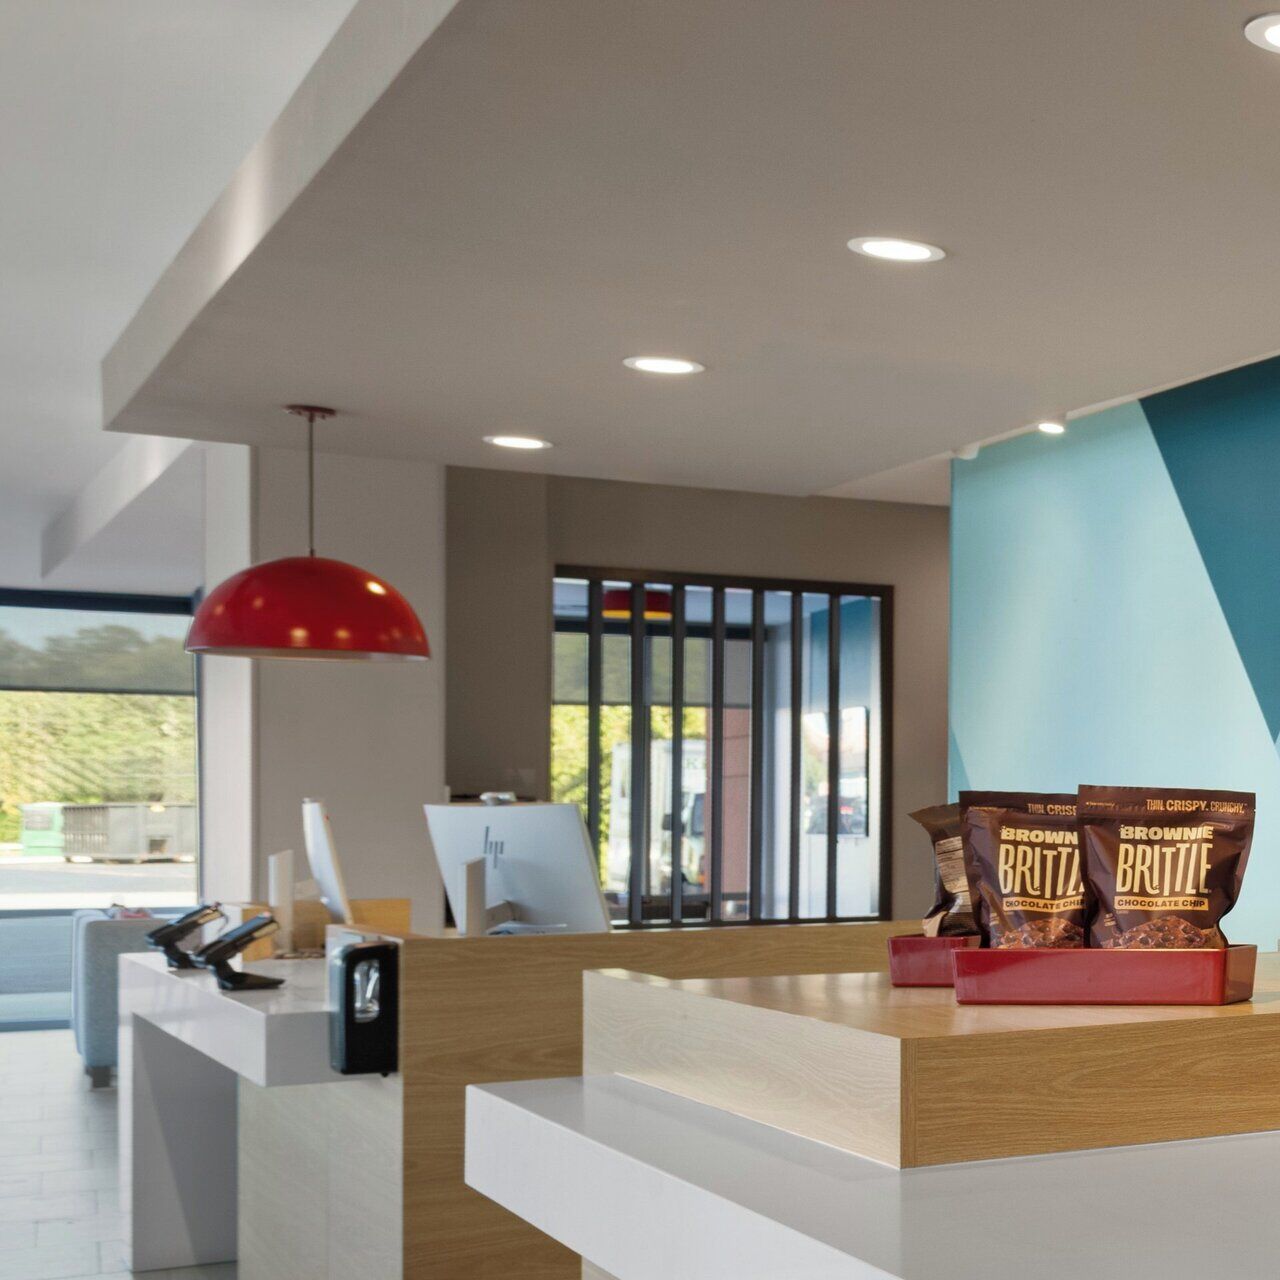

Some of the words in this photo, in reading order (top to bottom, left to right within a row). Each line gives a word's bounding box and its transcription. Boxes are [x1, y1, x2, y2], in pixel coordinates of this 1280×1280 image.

[1047, 804, 1076, 815] CRISP
[1166, 800, 1209, 812] CRISPY.
[1000, 827, 1079, 844] BROWN
[1119, 826, 1214, 840] BROWNIE
[999, 843, 1084, 899] BRITTL
[1115, 843, 1214, 897] BRITTLE
[1005, 901, 1061, 910] CHOCOLATE
[1117, 899, 1180, 908] CHOCOLATE
[1181, 899, 1206, 908] CHIP
